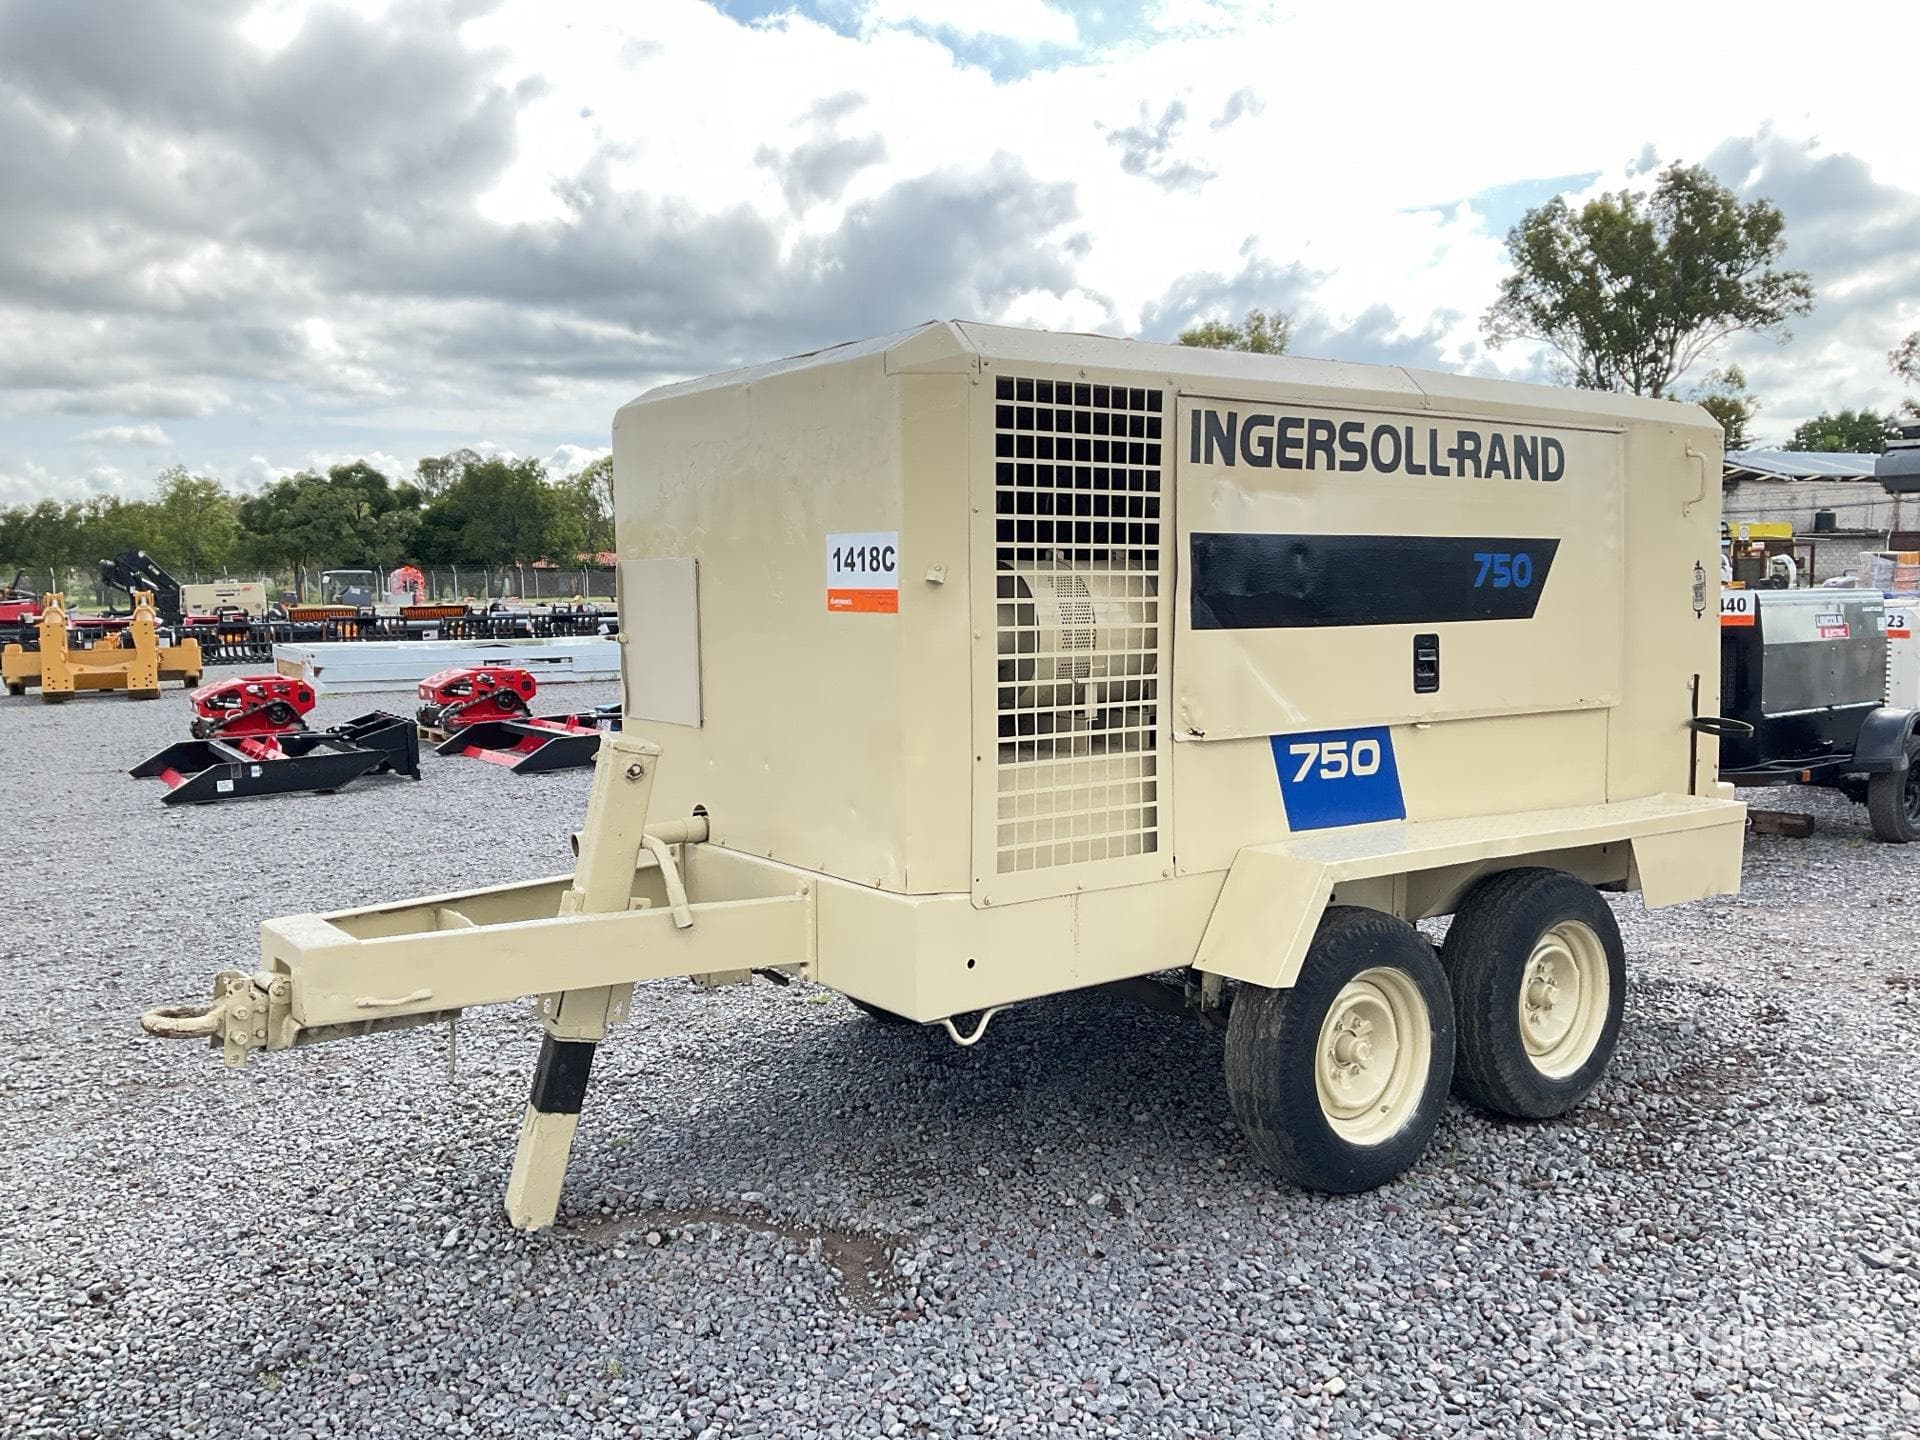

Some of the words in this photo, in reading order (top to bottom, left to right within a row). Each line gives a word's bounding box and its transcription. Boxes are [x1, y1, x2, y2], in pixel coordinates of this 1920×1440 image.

[832, 545, 896, 573] 1418C
[1473, 553, 1533, 588] 750
[1289, 740, 1380, 783] 750
